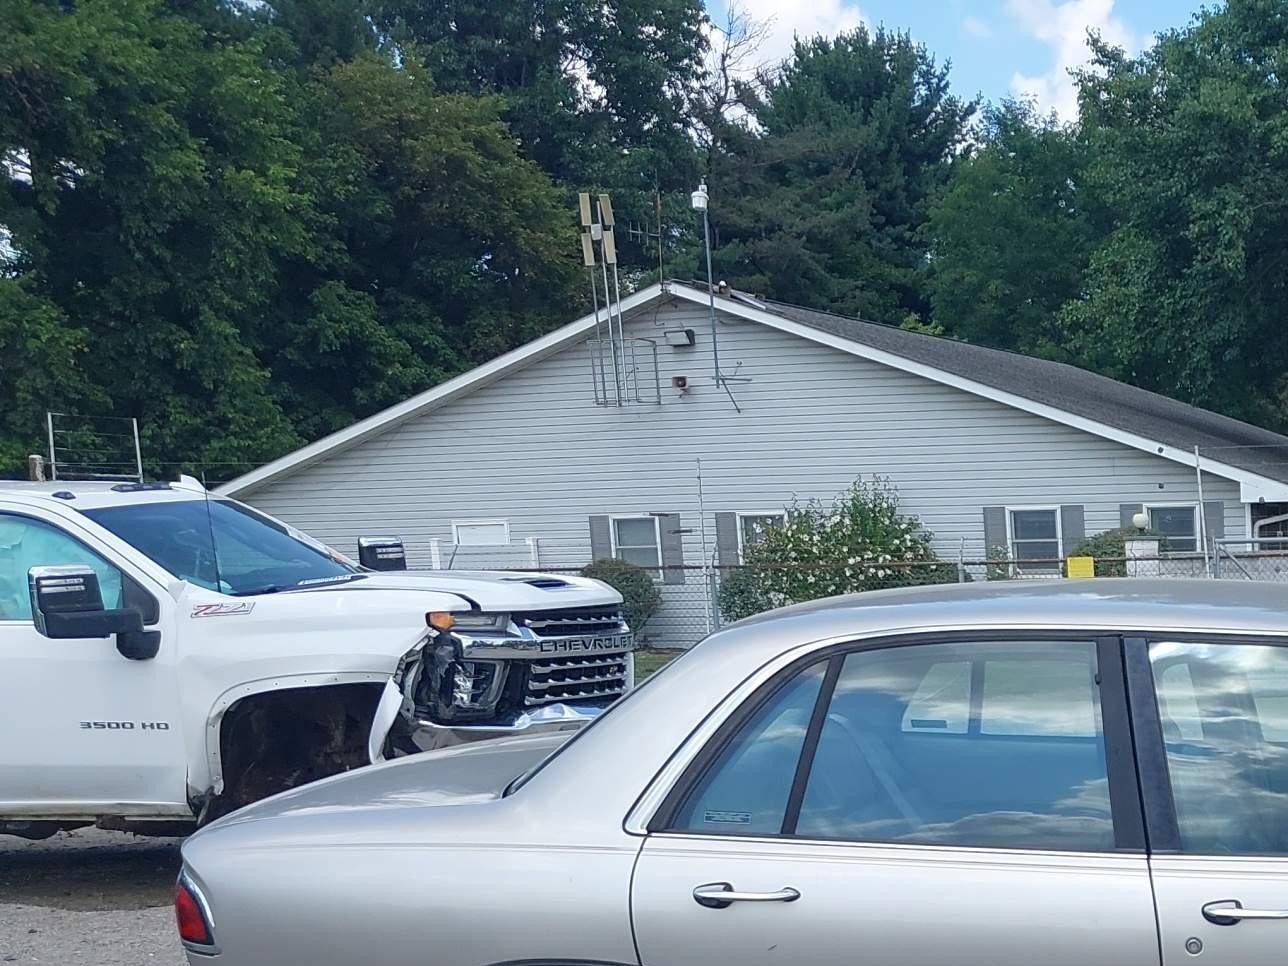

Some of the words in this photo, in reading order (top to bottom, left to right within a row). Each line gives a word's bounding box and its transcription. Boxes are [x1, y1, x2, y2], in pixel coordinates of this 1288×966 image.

[540, 636, 633, 652] CHEVROLET
[79, 721, 135, 730] 3500
[141, 722, 169, 730] HD
